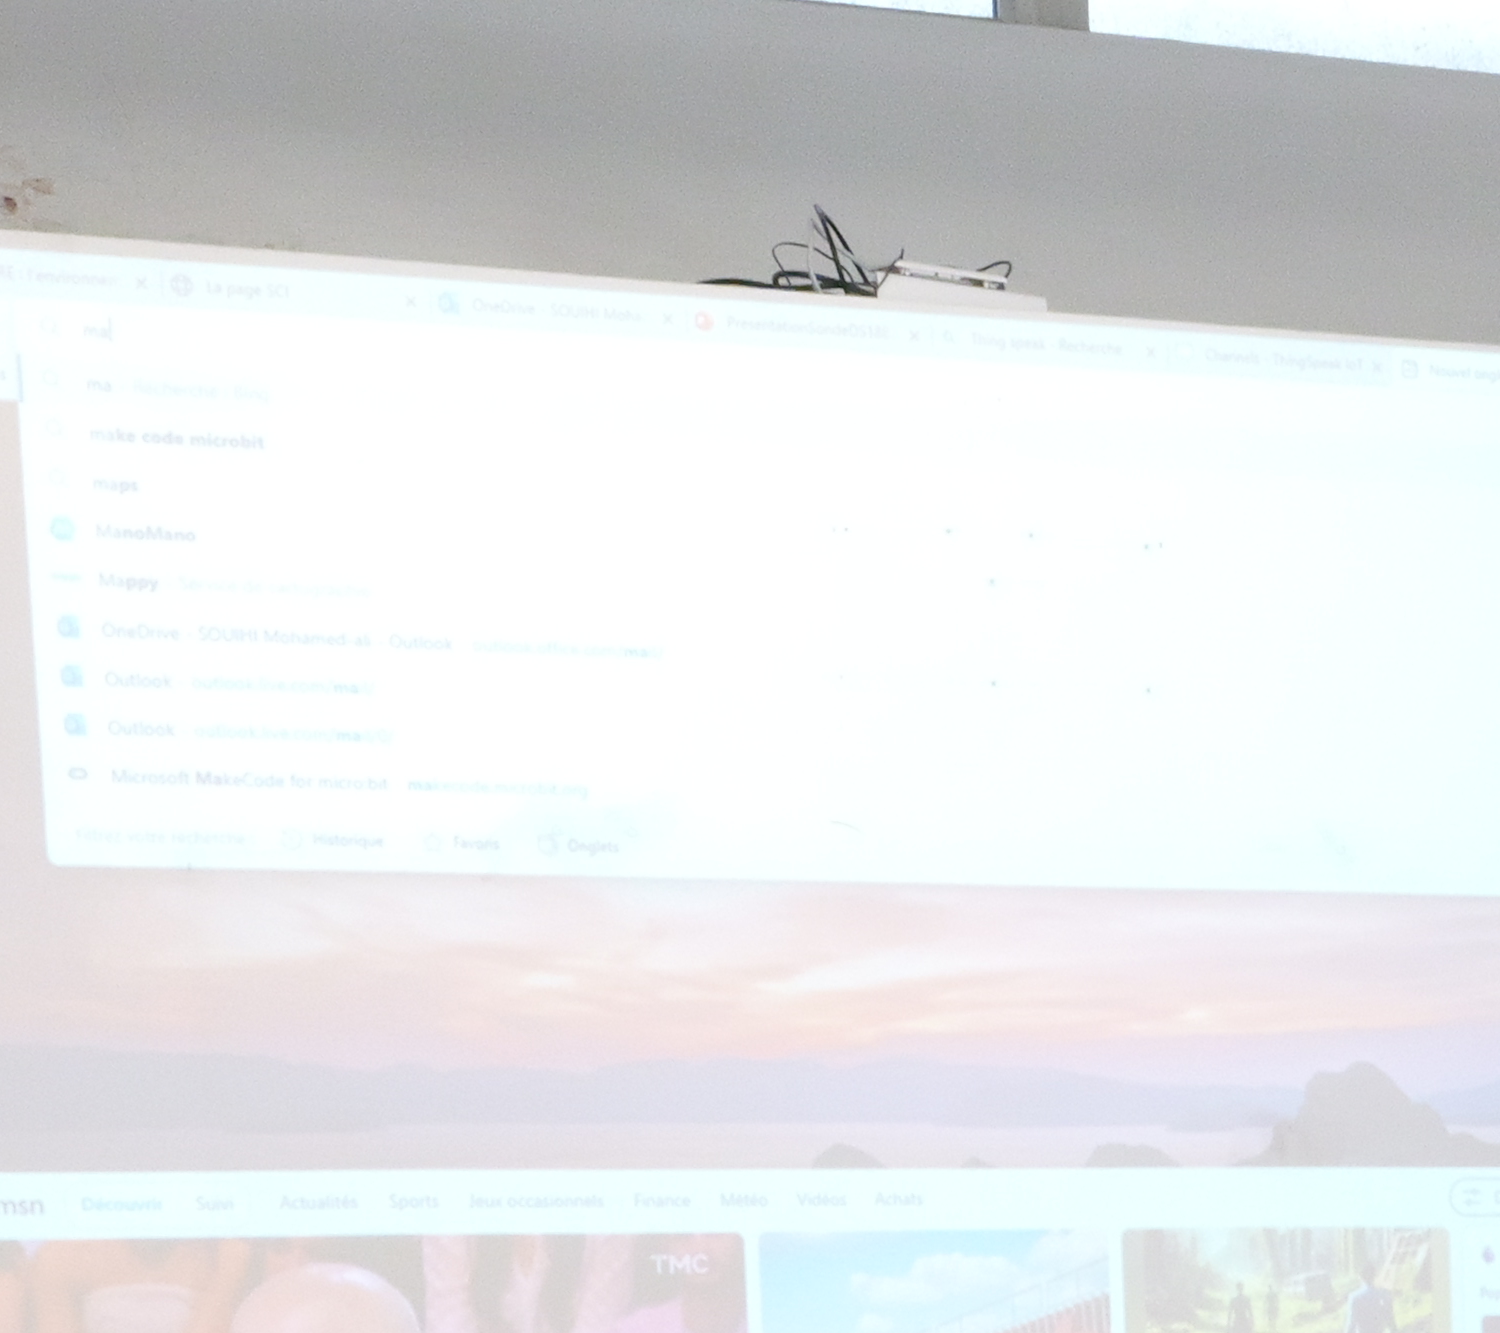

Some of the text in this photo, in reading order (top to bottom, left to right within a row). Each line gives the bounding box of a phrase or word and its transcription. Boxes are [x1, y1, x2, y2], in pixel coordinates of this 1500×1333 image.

[90, 426, 266, 450] make code microbit
[93, 478, 139, 494] maps
[96, 523, 196, 542] ManoMano
[99, 572, 159, 592] Mappy
[102, 621, 452, 651] OneDrive Outlook
[105, 672, 172, 690] Outlook
[107, 720, 175, 738] Outlook
[111, 769, 190, 787] Microsoft
[196, 772, 286, 789] MakeCode
[290, 773, 313, 789] for
[312, 832, 384, 851] Historique
[452, 834, 500, 852] Favoris
[567, 837, 620, 856] Onglets
[81, 1194, 163, 1213] Découvrir
[280, 1193, 360, 1212] Actualités
[389, 1192, 440, 1213] Sports
[507, 1190, 605, 1210] occasionnels
[634, 1192, 691, 1209] Finance
[720, 1191, 769, 1209] Météo
[797, 1191, 847, 1208] Vidéos
[875, 1191, 924, 1208] Achats
[650, 1253, 710, 1276] TMC
